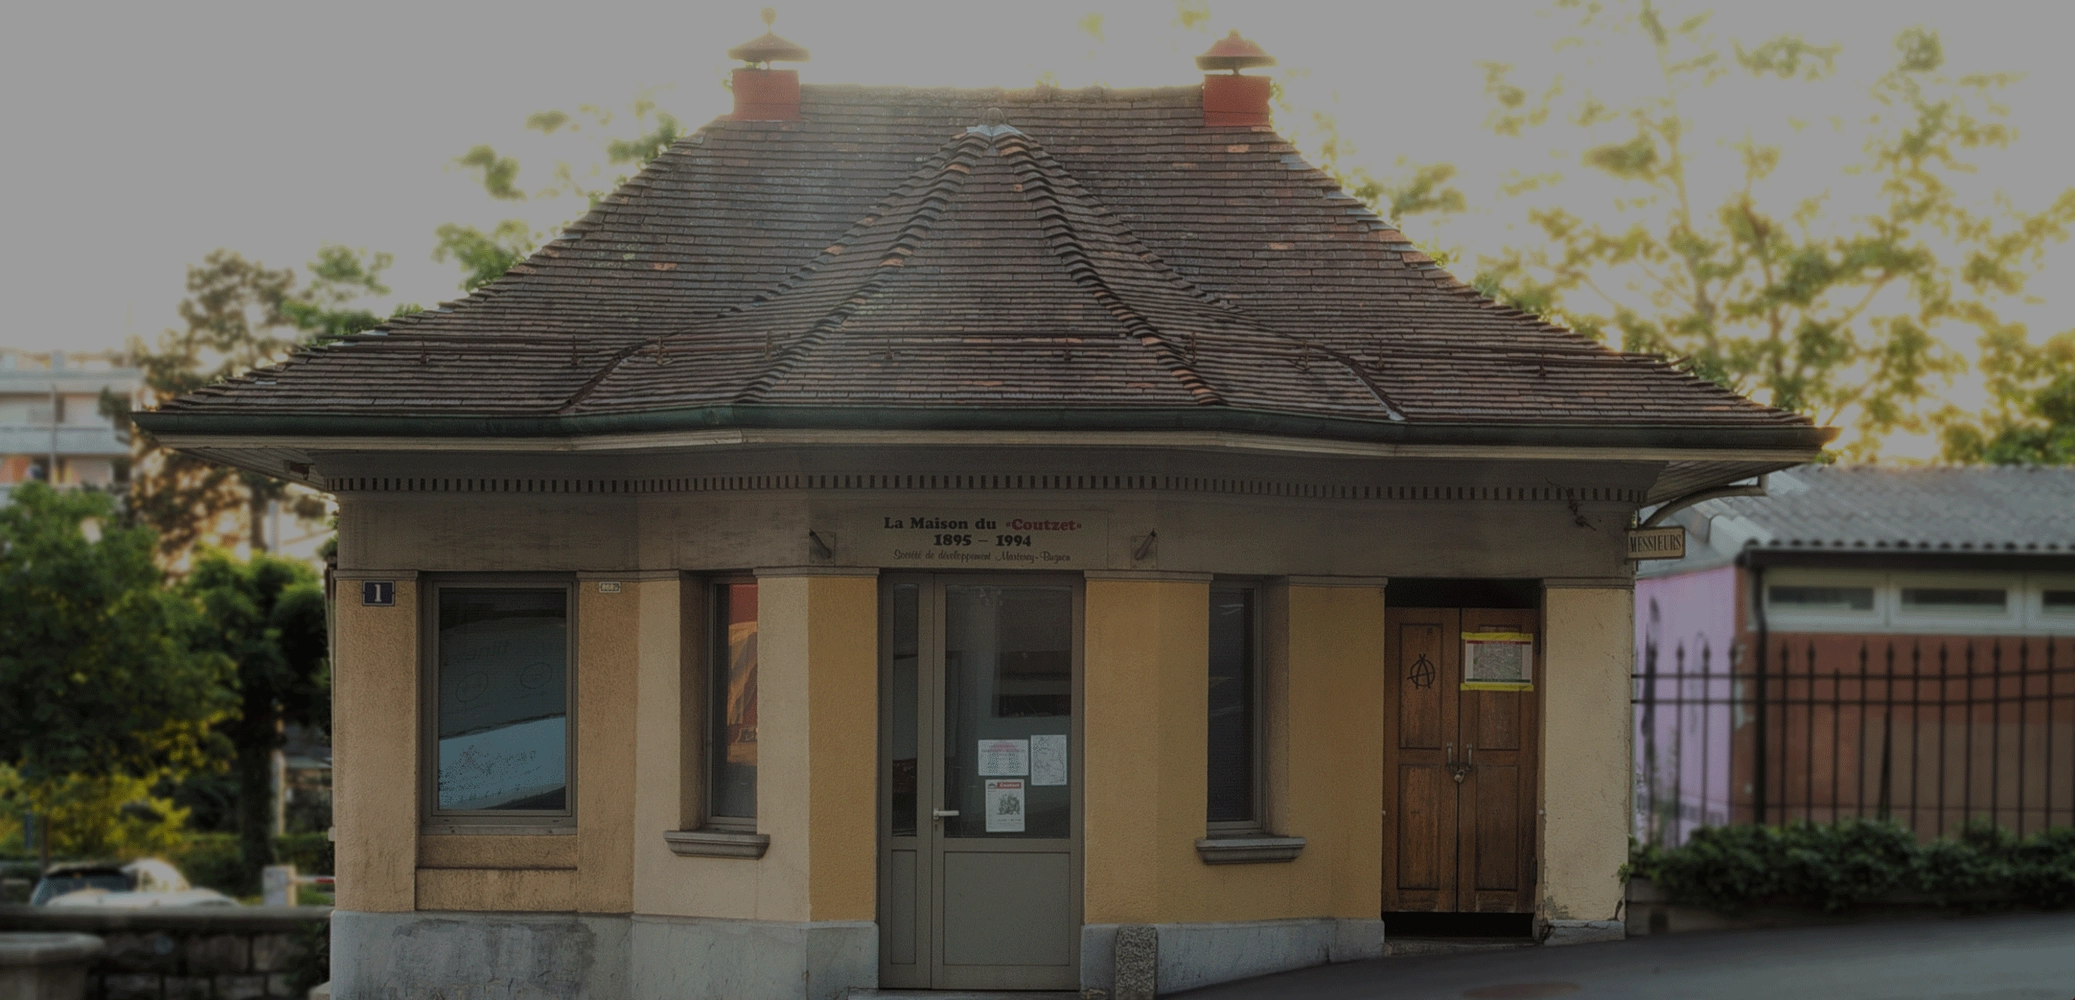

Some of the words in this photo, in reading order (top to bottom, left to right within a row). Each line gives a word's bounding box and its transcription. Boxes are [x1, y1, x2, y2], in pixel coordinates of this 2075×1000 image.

[884, 517, 903, 530] La
[910, 516, 968, 530] Maison
[975, 517, 997, 530] du
[1006, 517, 1082, 531] «Coutzet»
[934, 533, 972, 546] 1895
[995, 534, 1031, 547] 1994
[1630, 534, 1682, 553] MESSIEURS
[925, 549, 934, 558] de
[374, 584, 382, 602] 1
